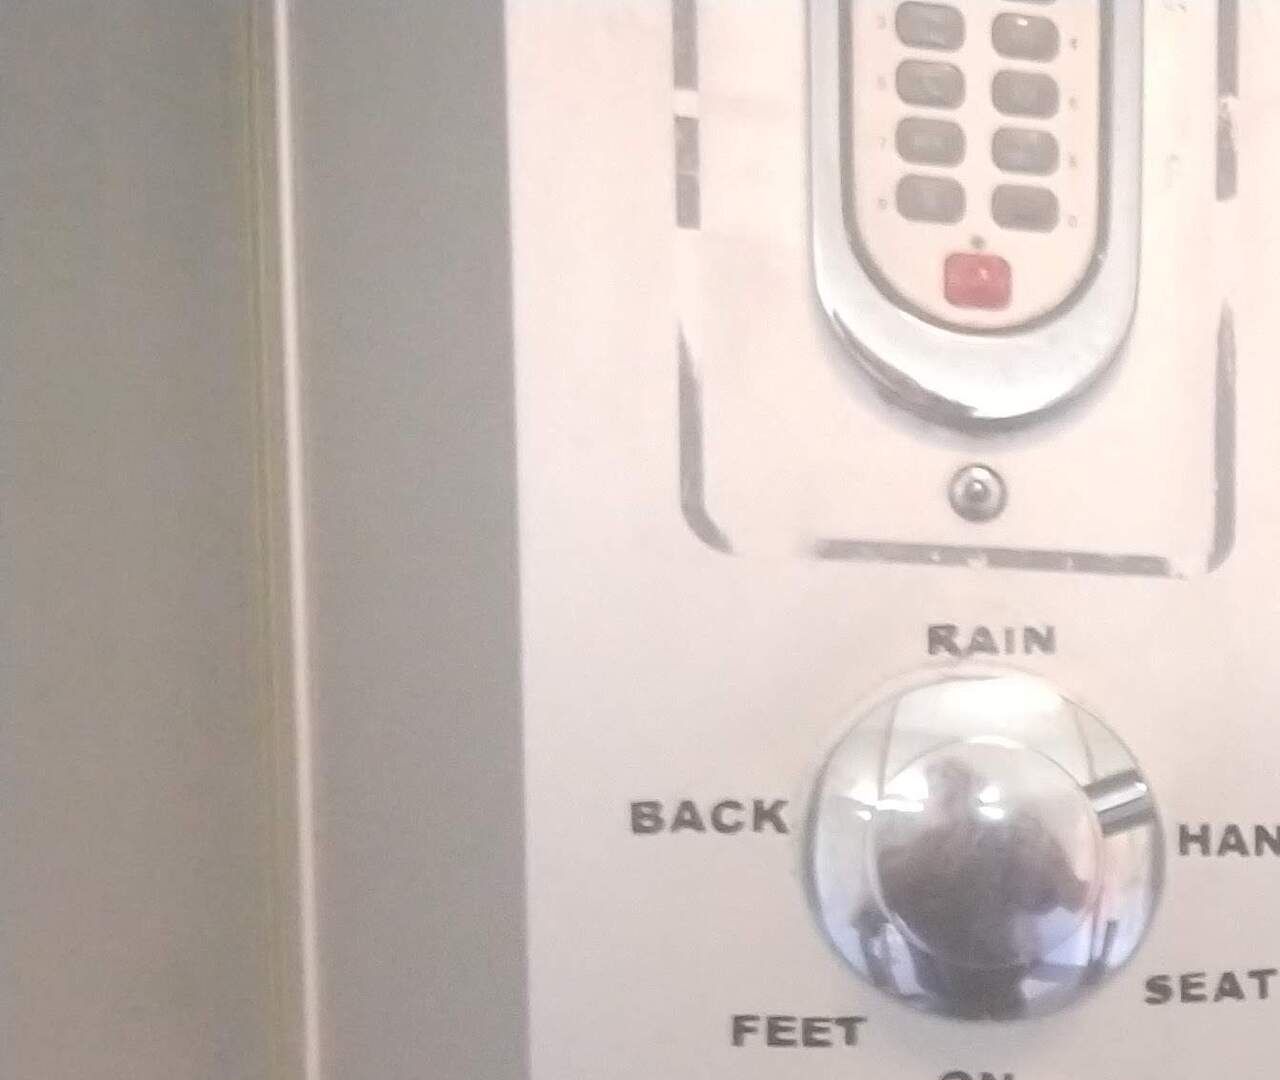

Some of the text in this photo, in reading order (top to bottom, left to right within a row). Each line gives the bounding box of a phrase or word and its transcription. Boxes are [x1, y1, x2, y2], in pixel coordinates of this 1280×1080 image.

[926, 623, 1056, 657] RAIN
[630, 799, 790, 837] BACK
[1144, 968, 1279, 1006] SEAT
[729, 1014, 868, 1048] FEET
